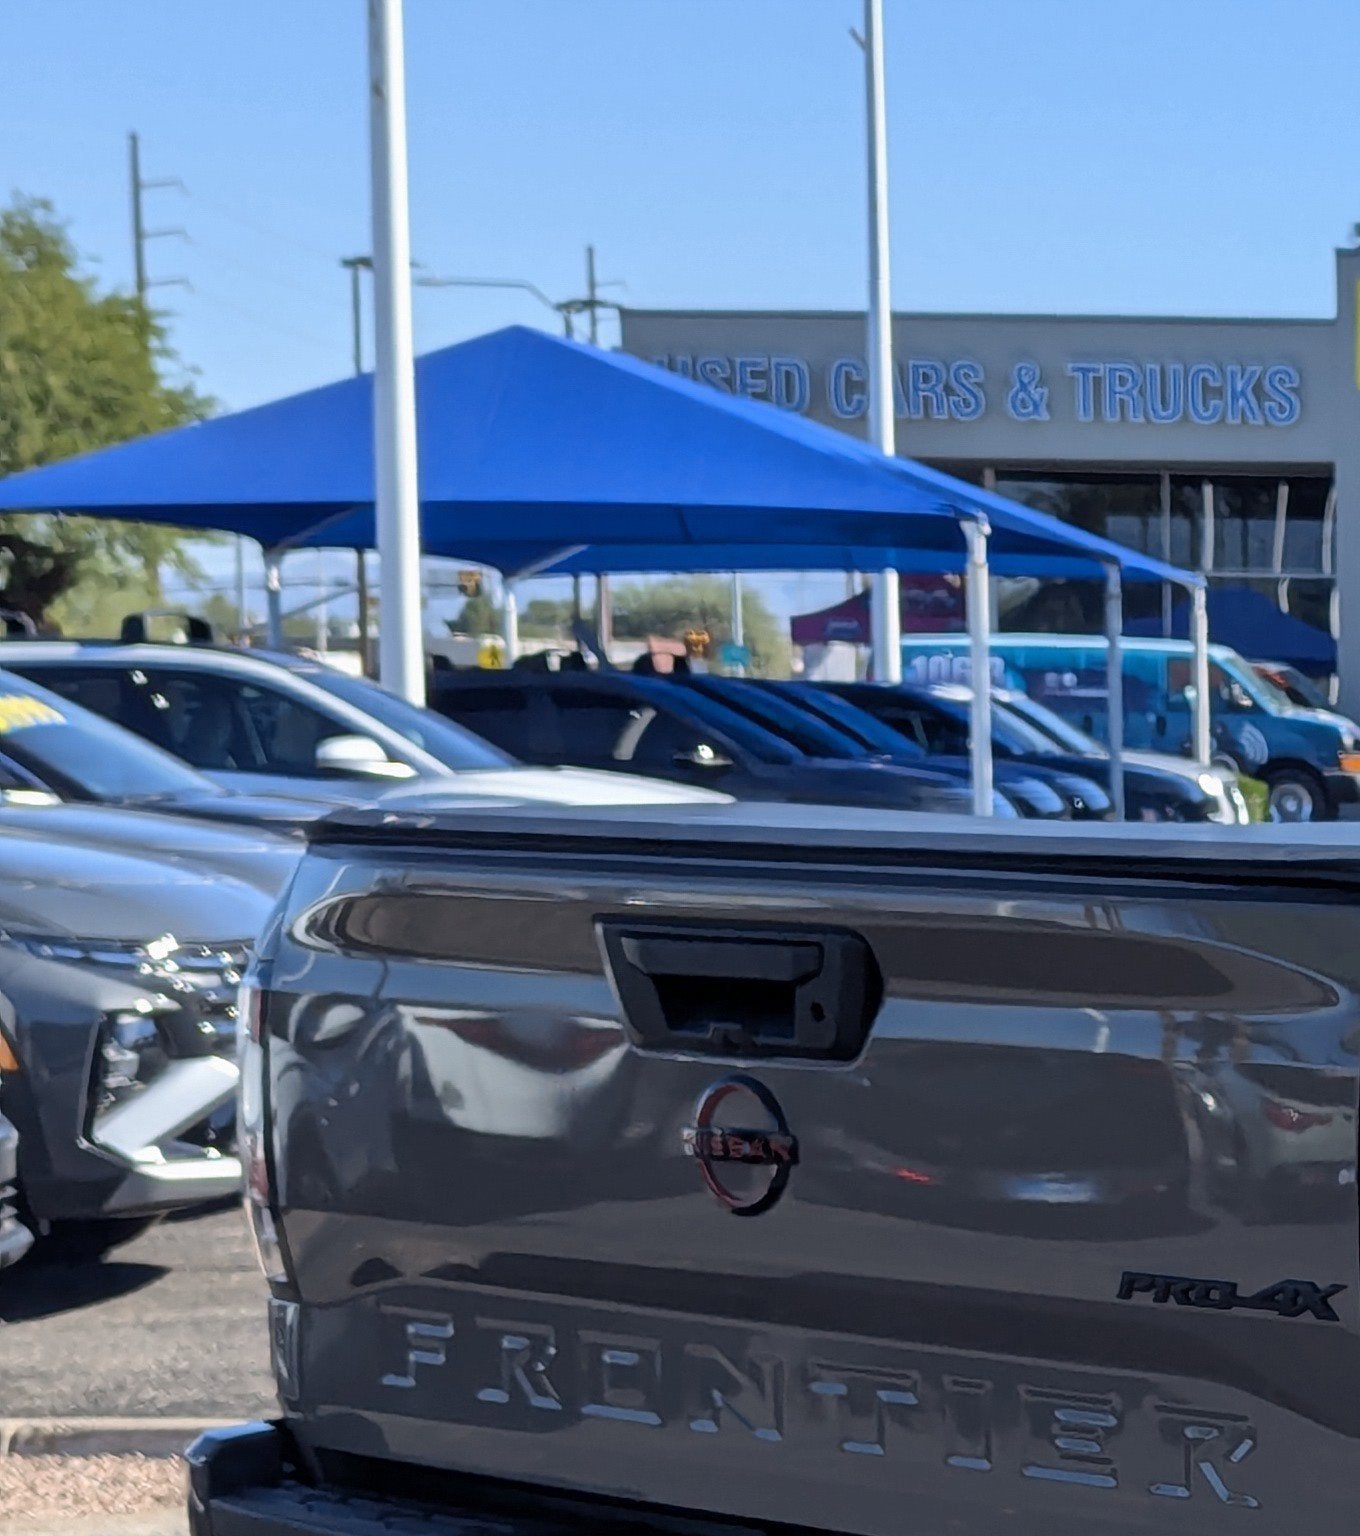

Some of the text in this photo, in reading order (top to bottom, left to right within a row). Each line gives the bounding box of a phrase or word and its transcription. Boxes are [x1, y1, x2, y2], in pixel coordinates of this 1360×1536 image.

[829, 357, 986, 421] CRS
[1008, 361, 1049, 421] &
[1065, 361, 1300, 425] TRUCKS
[1116, 1271, 1347, 1322] PRO-4X
[377, 1303, 1260, 1508] FRONTIER
